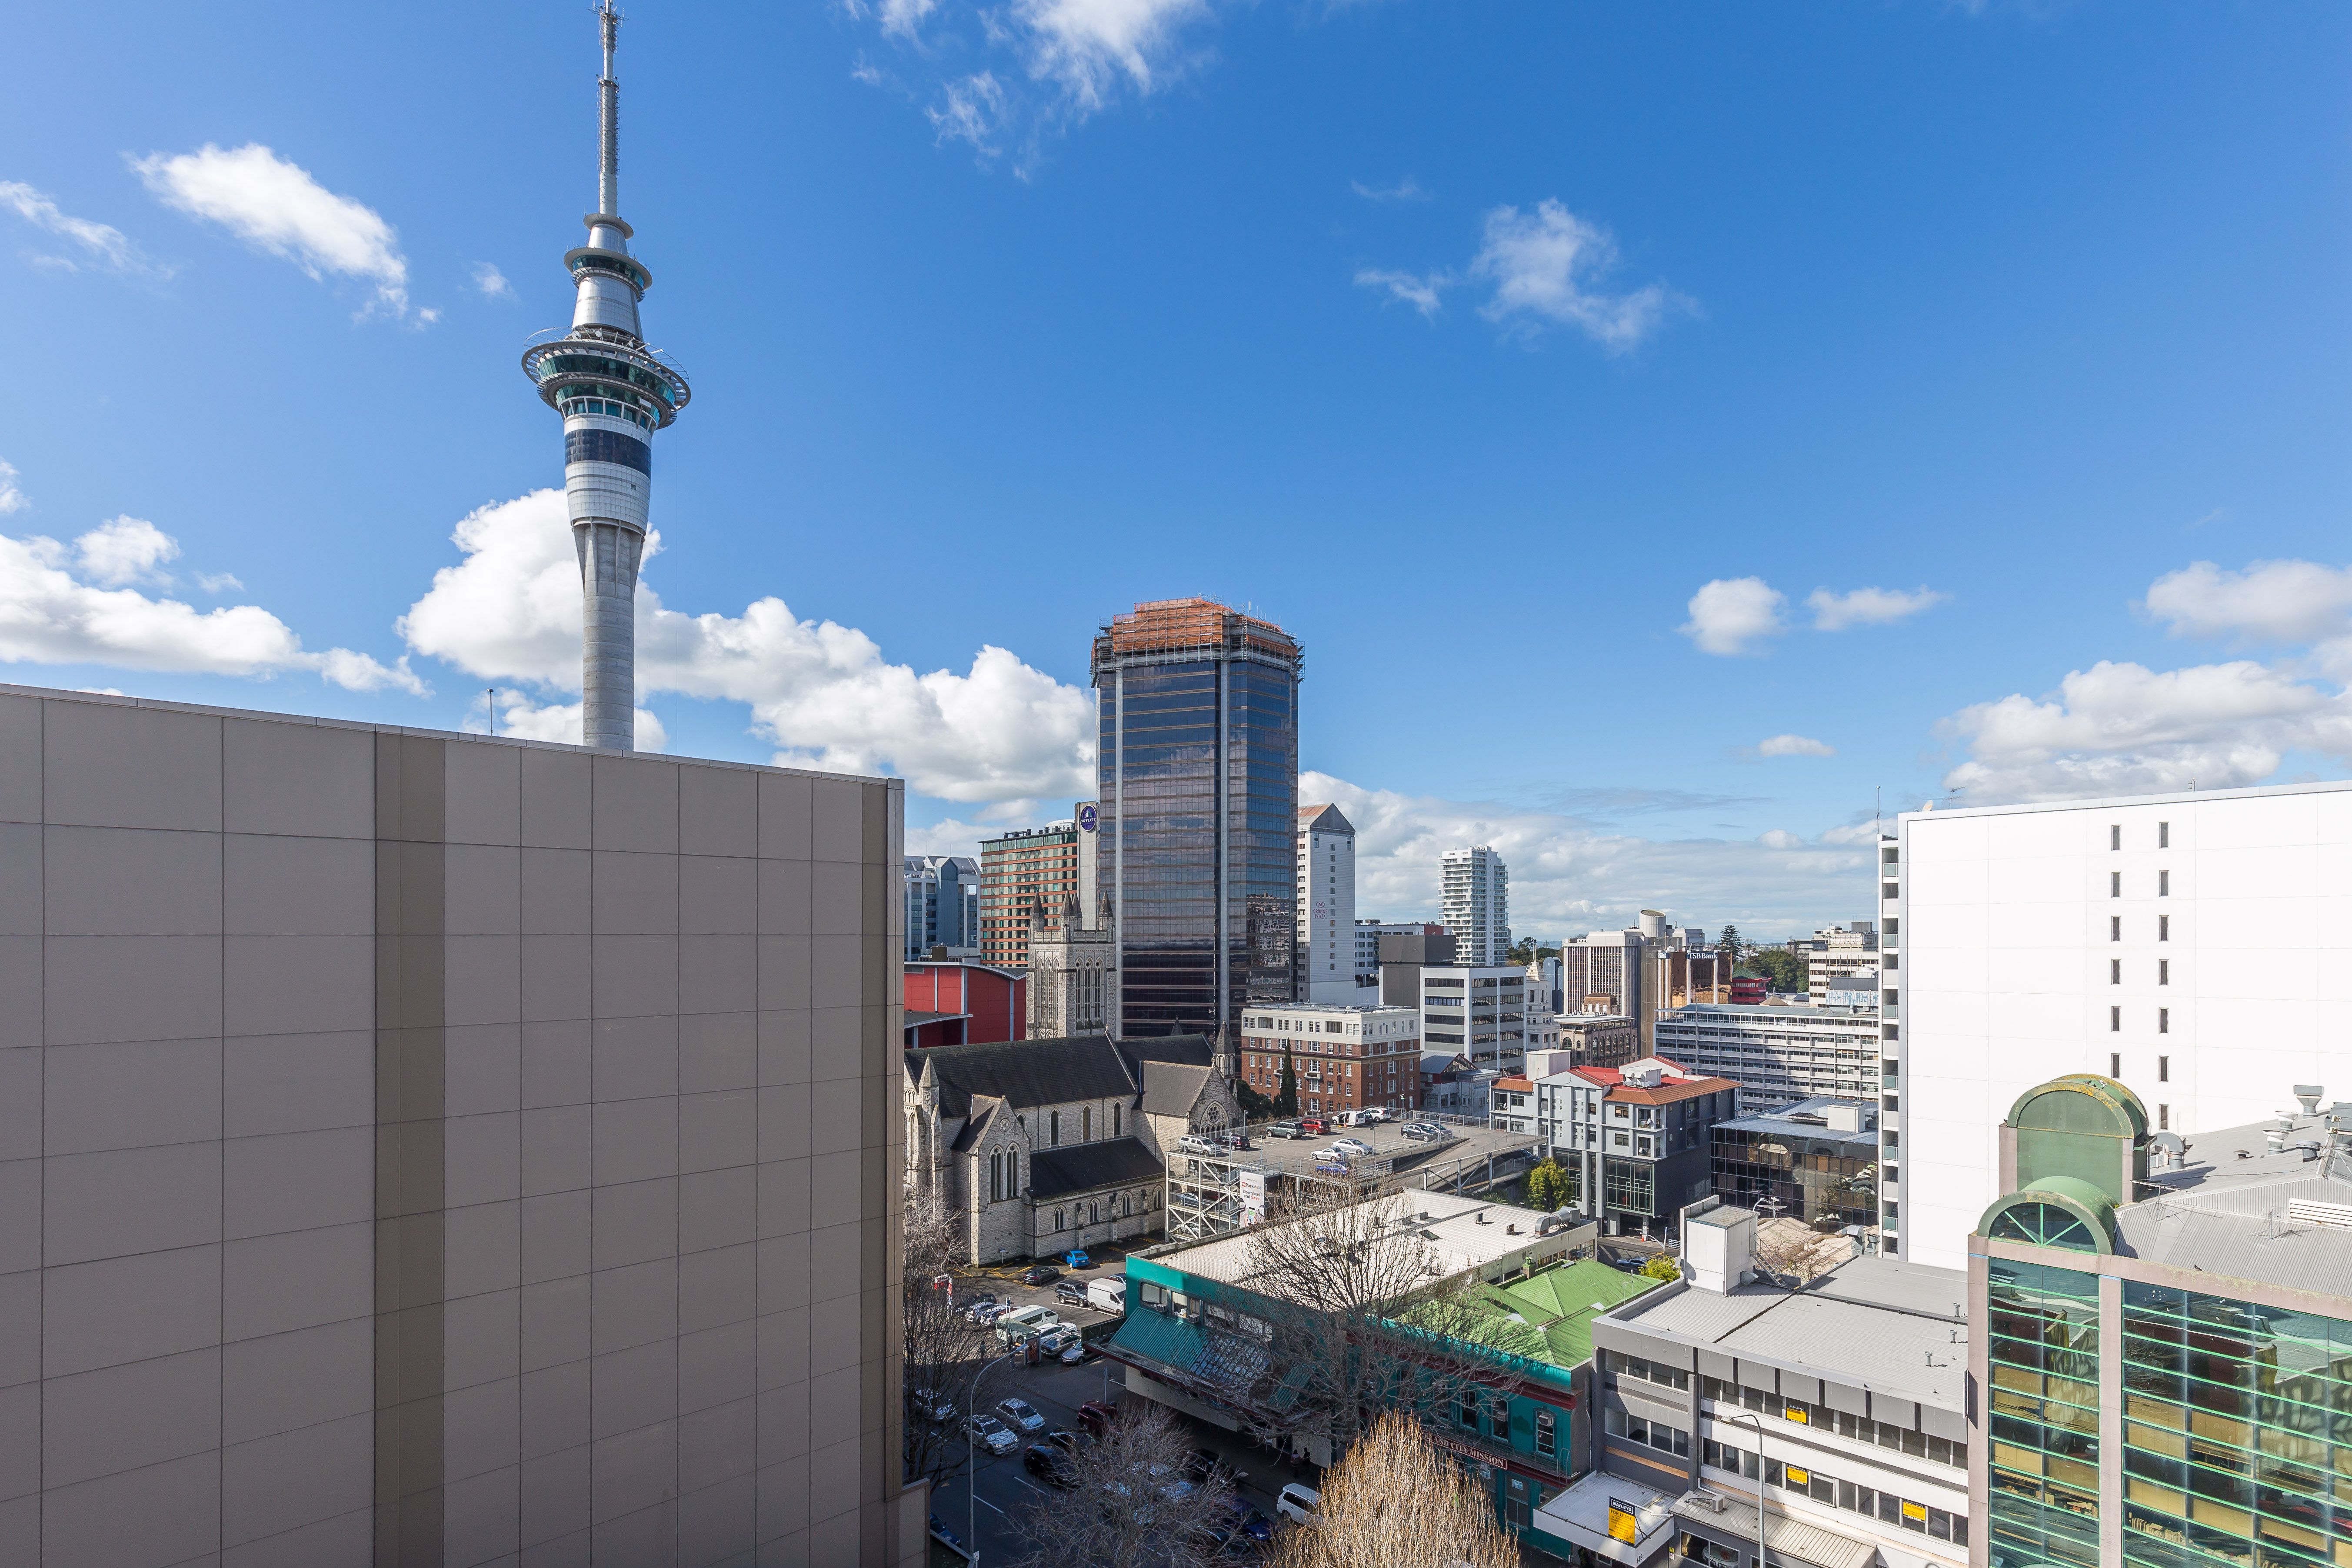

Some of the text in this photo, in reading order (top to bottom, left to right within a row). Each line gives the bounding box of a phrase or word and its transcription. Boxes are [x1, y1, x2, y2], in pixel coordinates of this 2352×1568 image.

[1470, 1449, 1504, 1467] MISSION
[1613, 1501, 1632, 1511] BAYLEYS
[1619, 1512, 1632, 1521] LEASE
